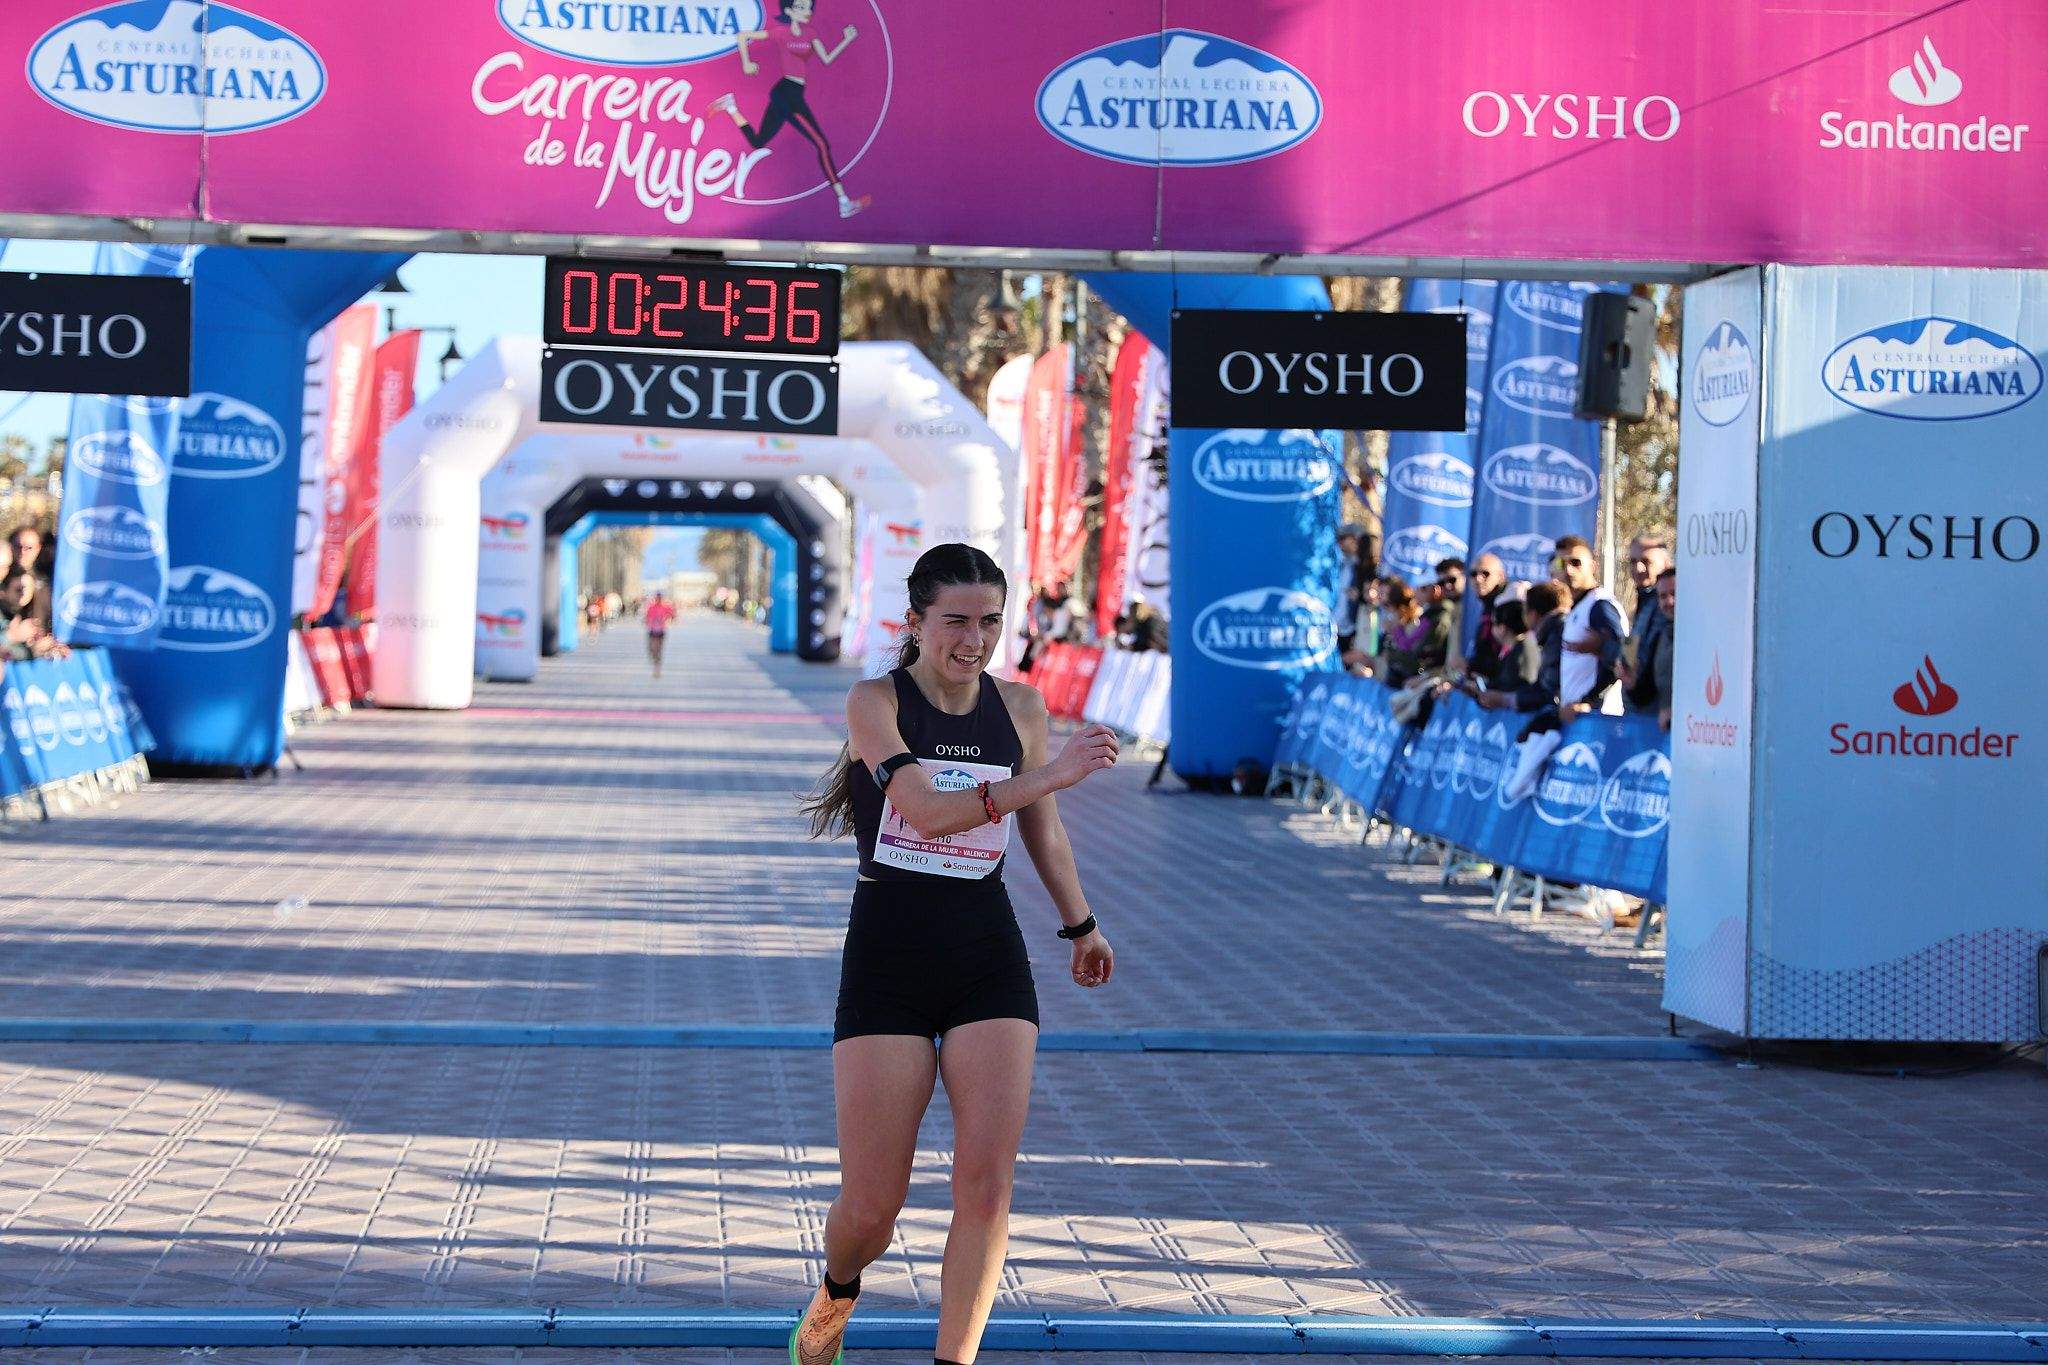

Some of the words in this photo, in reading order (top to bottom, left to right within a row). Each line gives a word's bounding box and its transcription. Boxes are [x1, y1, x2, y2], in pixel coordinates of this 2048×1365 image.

[519, 0, 741, 35] ASTURIANA
[97, 39, 190, 55] CENTRAL
[203, 46, 294, 61] ECHERA
[52, 42, 301, 101] ASTURIANA
[471, 52, 692, 124] Carrera
[1103, 76, 1192, 90] CENTRAL
[1201, 78, 1291, 92] LECHERA
[1059, 78, 1299, 131] ASTURIANA
[1462, 91, 1681, 142] OYSHO
[1819, 111, 2030, 152] Santander
[523, 121, 567, 166] de
[573, 119, 605, 168] la
[595, 117, 773, 225] Mujer
[563, 270, 821, 344] 00:24:36
[0, 312, 147, 359] SHO
[1218, 350, 1424, 397] OYSHO
[1838, 354, 2026, 396] ASTURIANA
[1873, 352, 1941, 363] CENTRAL
[1949, 354, 2020, 366] LECHERA
[553, 359, 827, 426] OYSHO
[1687, 509, 1748, 557] OYSHO
[1811, 511, 2041, 563] OYSHO
[935, 744, 981, 757] OYSHO
[1686, 713, 1738, 748] Santander
[1829, 722, 2019, 758] Santander
[933, 777, 975, 789] ASTURIANA
[889, 850, 929, 866] OYSHO
[952, 862, 990, 873] Santander
[894, 838, 920, 850] CARRERA
[921, 843, 929, 851] DE
[938, 846, 958, 855] MUJER
[963, 849, 990, 859] VALENCIA
